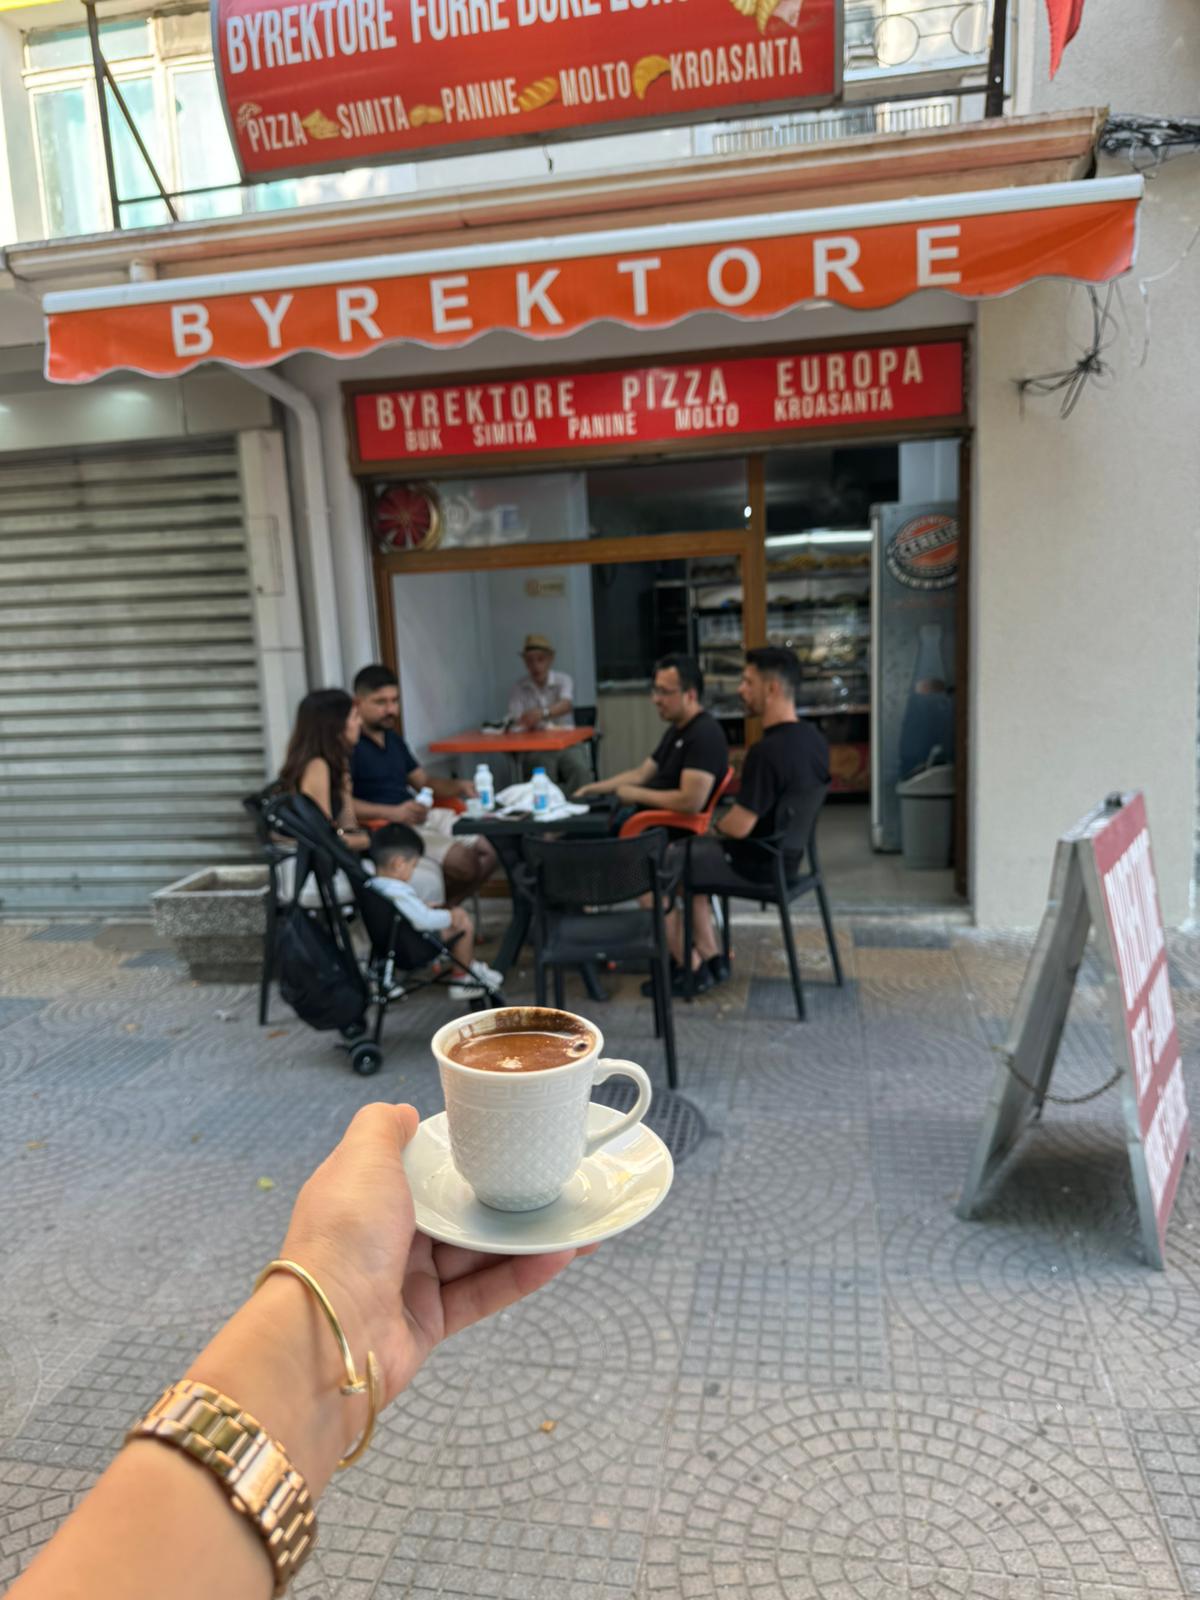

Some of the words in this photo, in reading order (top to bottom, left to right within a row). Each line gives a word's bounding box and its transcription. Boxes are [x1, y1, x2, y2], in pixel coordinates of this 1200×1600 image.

[226, 0, 398, 74] BYREKTORE
[247, 111, 308, 152] PIZZA
[336, 95, 410, 139] SIMITA
[440, 78, 520, 123] PANINE
[559, 61, 631, 106] MOLTO
[670, 36, 803, 91] KROASANTA
[170, 224, 962, 358] BYREKTORE
[376, 380, 576, 431] BYREKTORE
[622, 367, 728, 412] PIZZA
[776, 346, 924, 398] EUROPA
[472, 420, 537, 448] SIMITA
[568, 411, 638, 440] PANINE
[675, 402, 740, 431] MOLTO
[774, 386, 894, 422] KROASANTA
